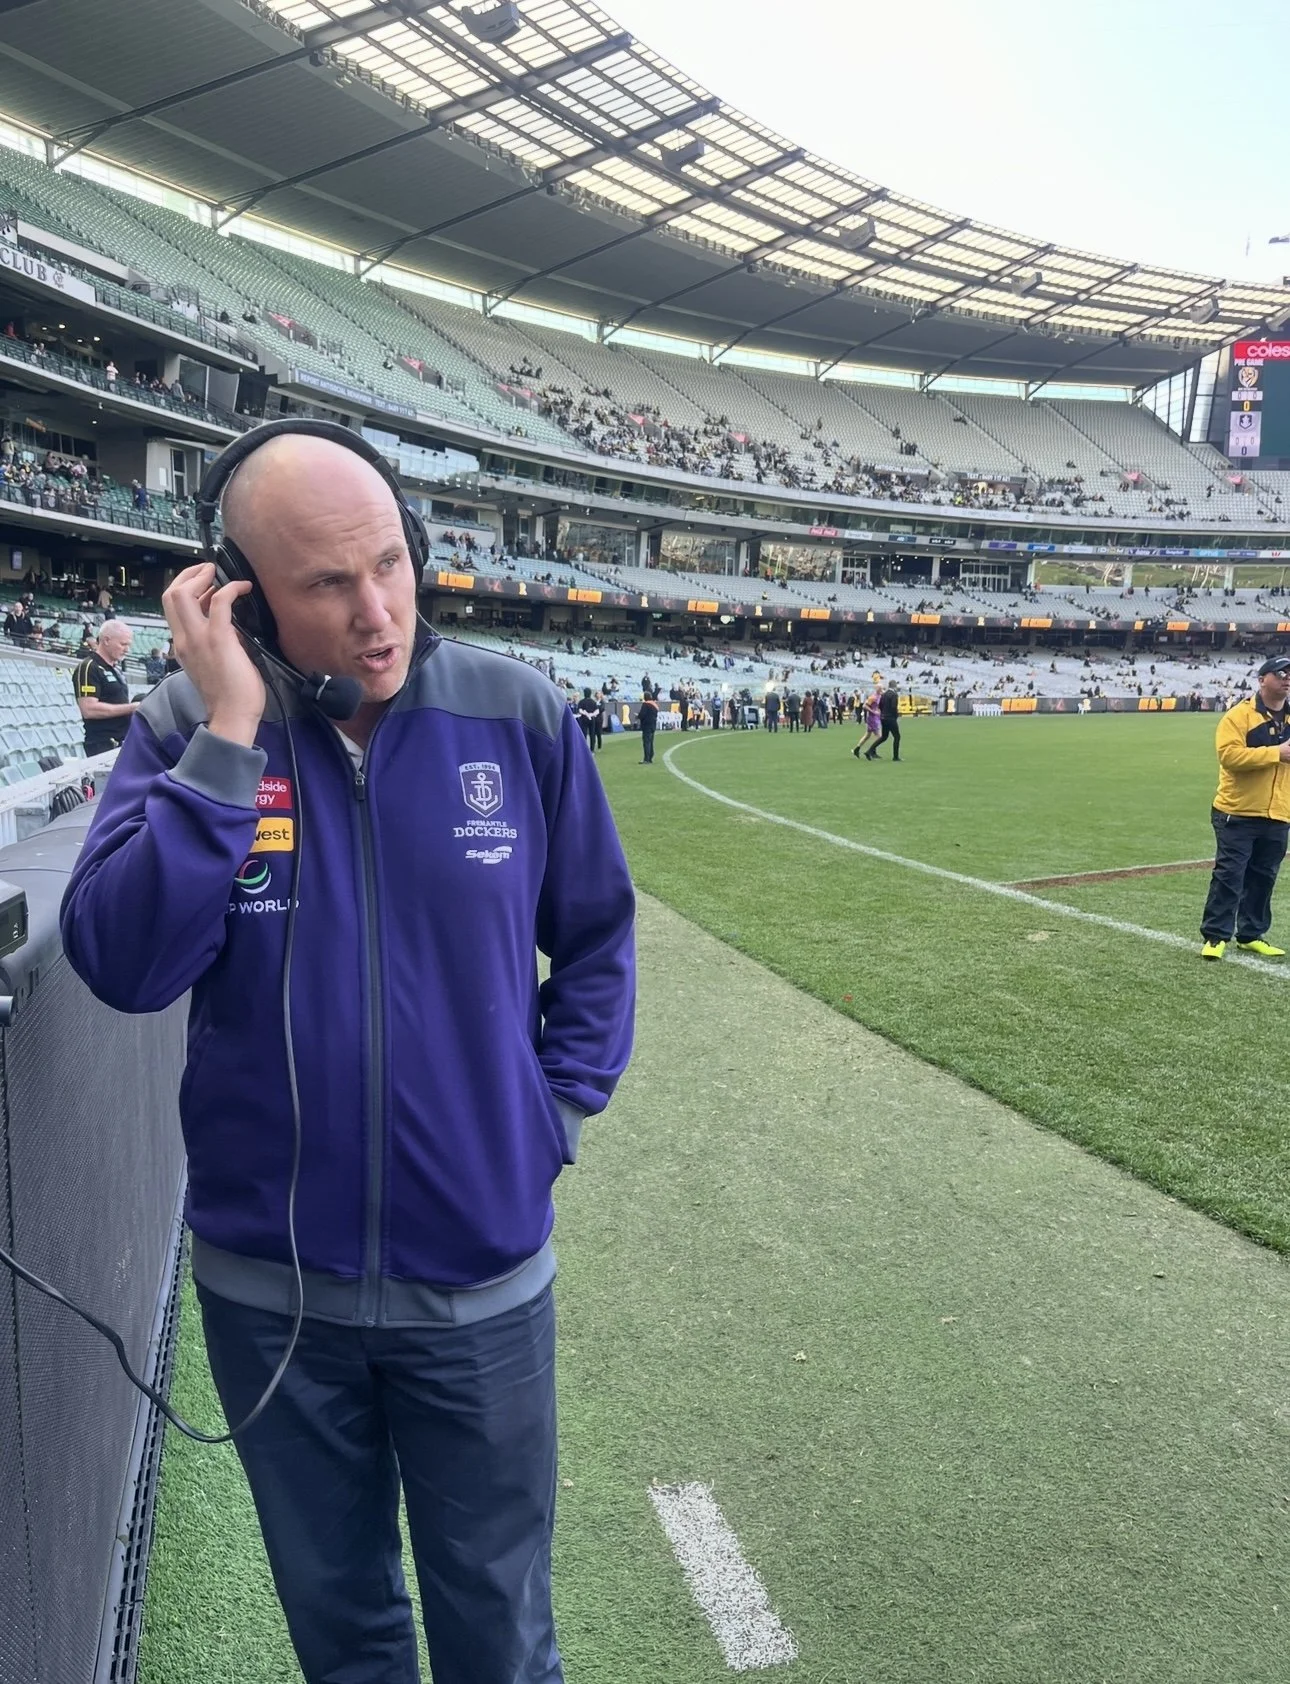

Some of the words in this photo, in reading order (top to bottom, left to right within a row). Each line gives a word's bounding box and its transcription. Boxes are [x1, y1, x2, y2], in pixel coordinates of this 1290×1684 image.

[0, 247, 47, 281] CLUB
[1247, 342, 1290, 358] coles
[1234, 358, 1245, 366] PRE
[1246, 358, 1264, 366] GAME
[1243, 401, 1250, 411] 0
[1241, 446, 1247, 456] 0
[467, 820, 507, 828] FREMANTLE
[453, 827, 518, 839] DOCKERS
